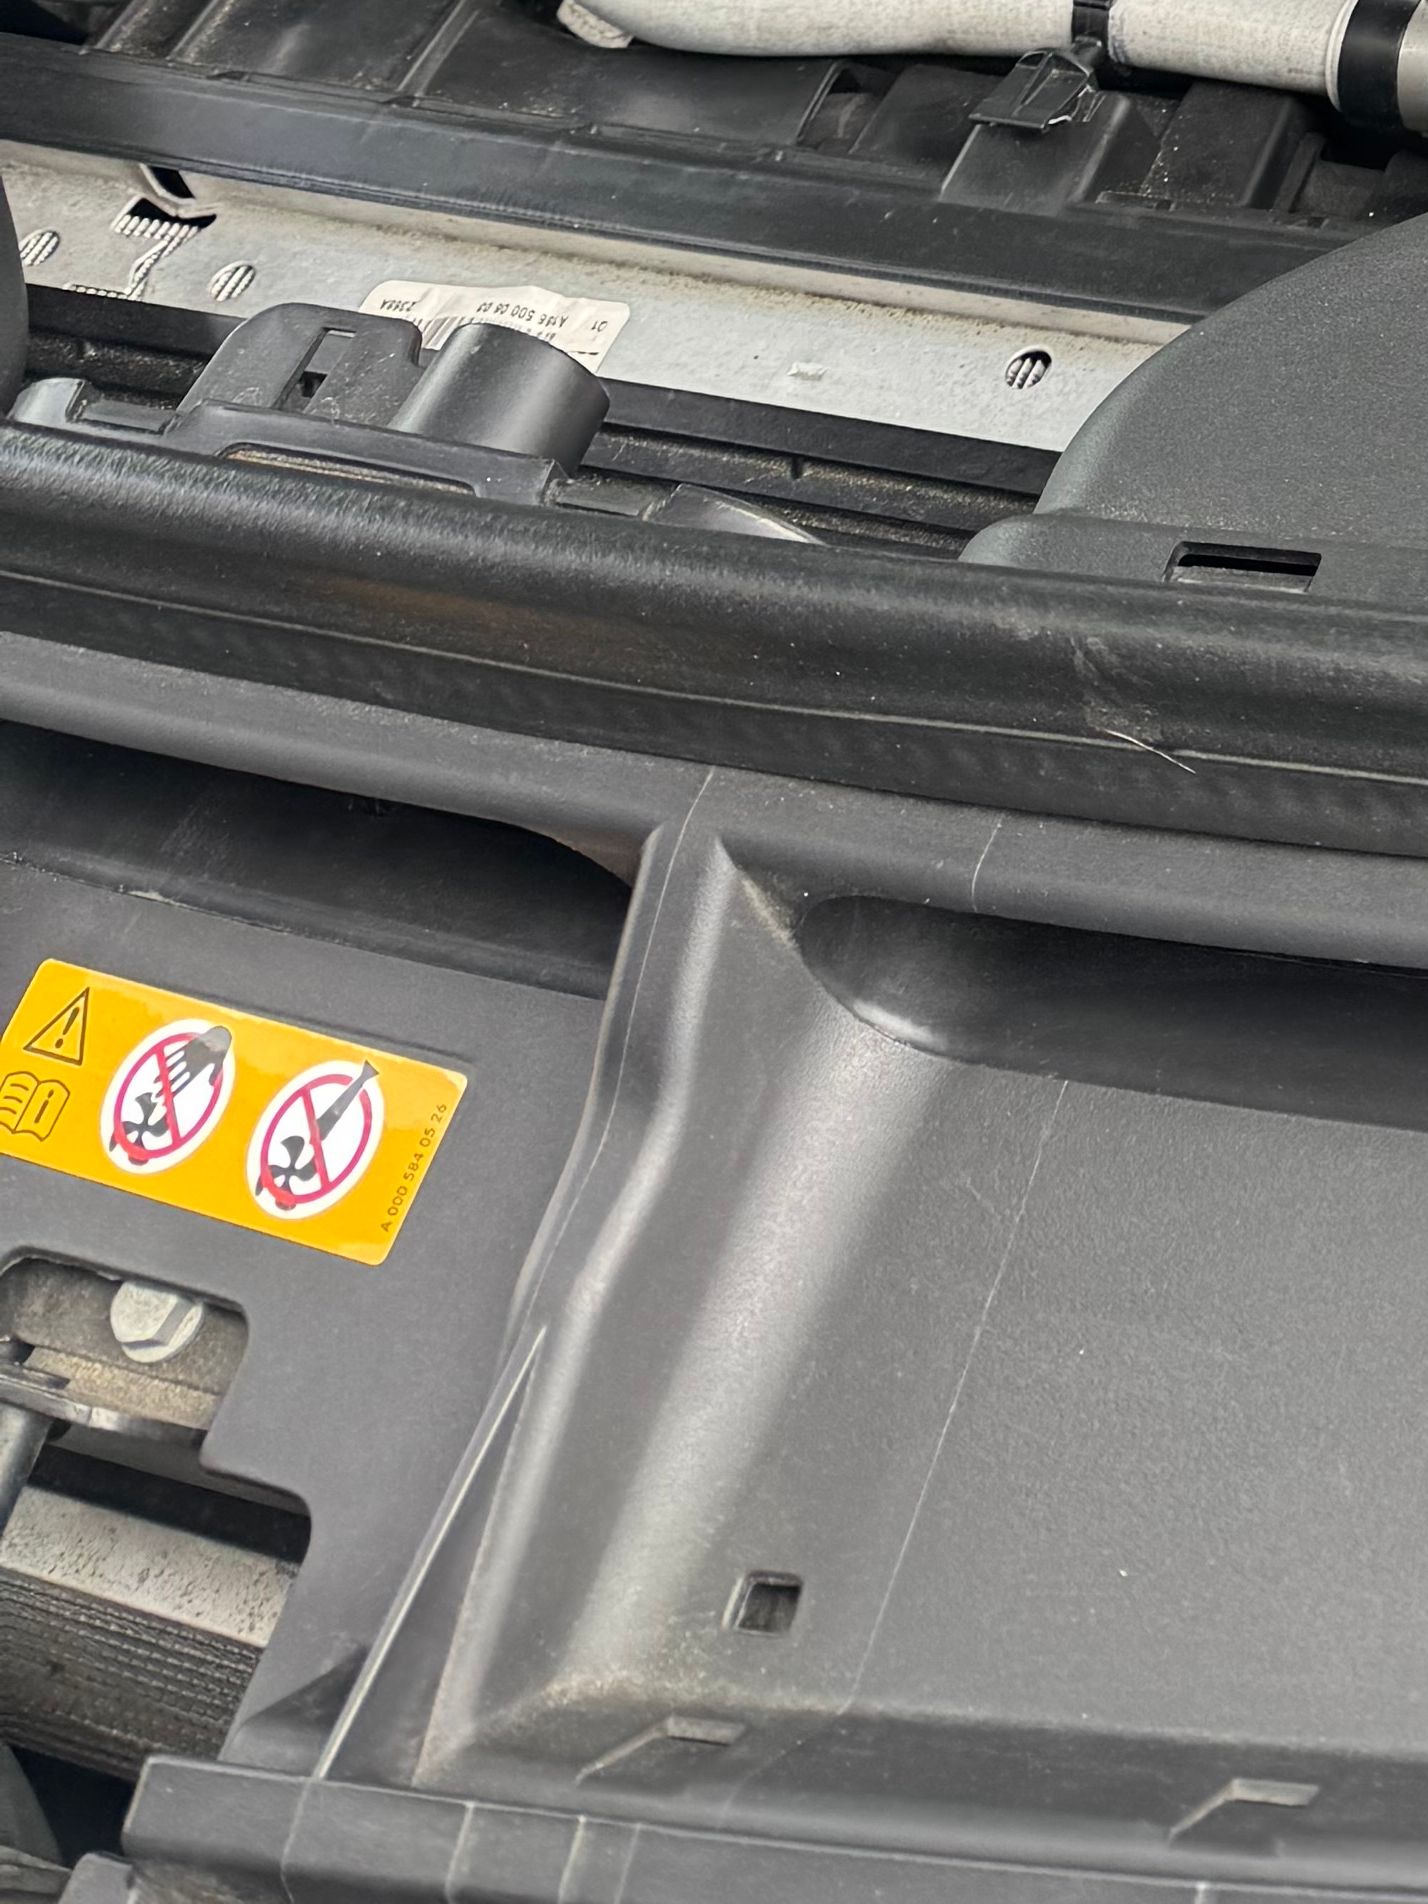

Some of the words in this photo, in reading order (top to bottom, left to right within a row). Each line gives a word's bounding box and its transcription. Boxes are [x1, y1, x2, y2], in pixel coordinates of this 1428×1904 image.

[380, 1220, 394, 1233] A
[387, 1185, 408, 1217] 000
[403, 1152, 424, 1182] 584
[419, 1127, 436, 1149] 05
[430, 1103, 448, 1124] 26
